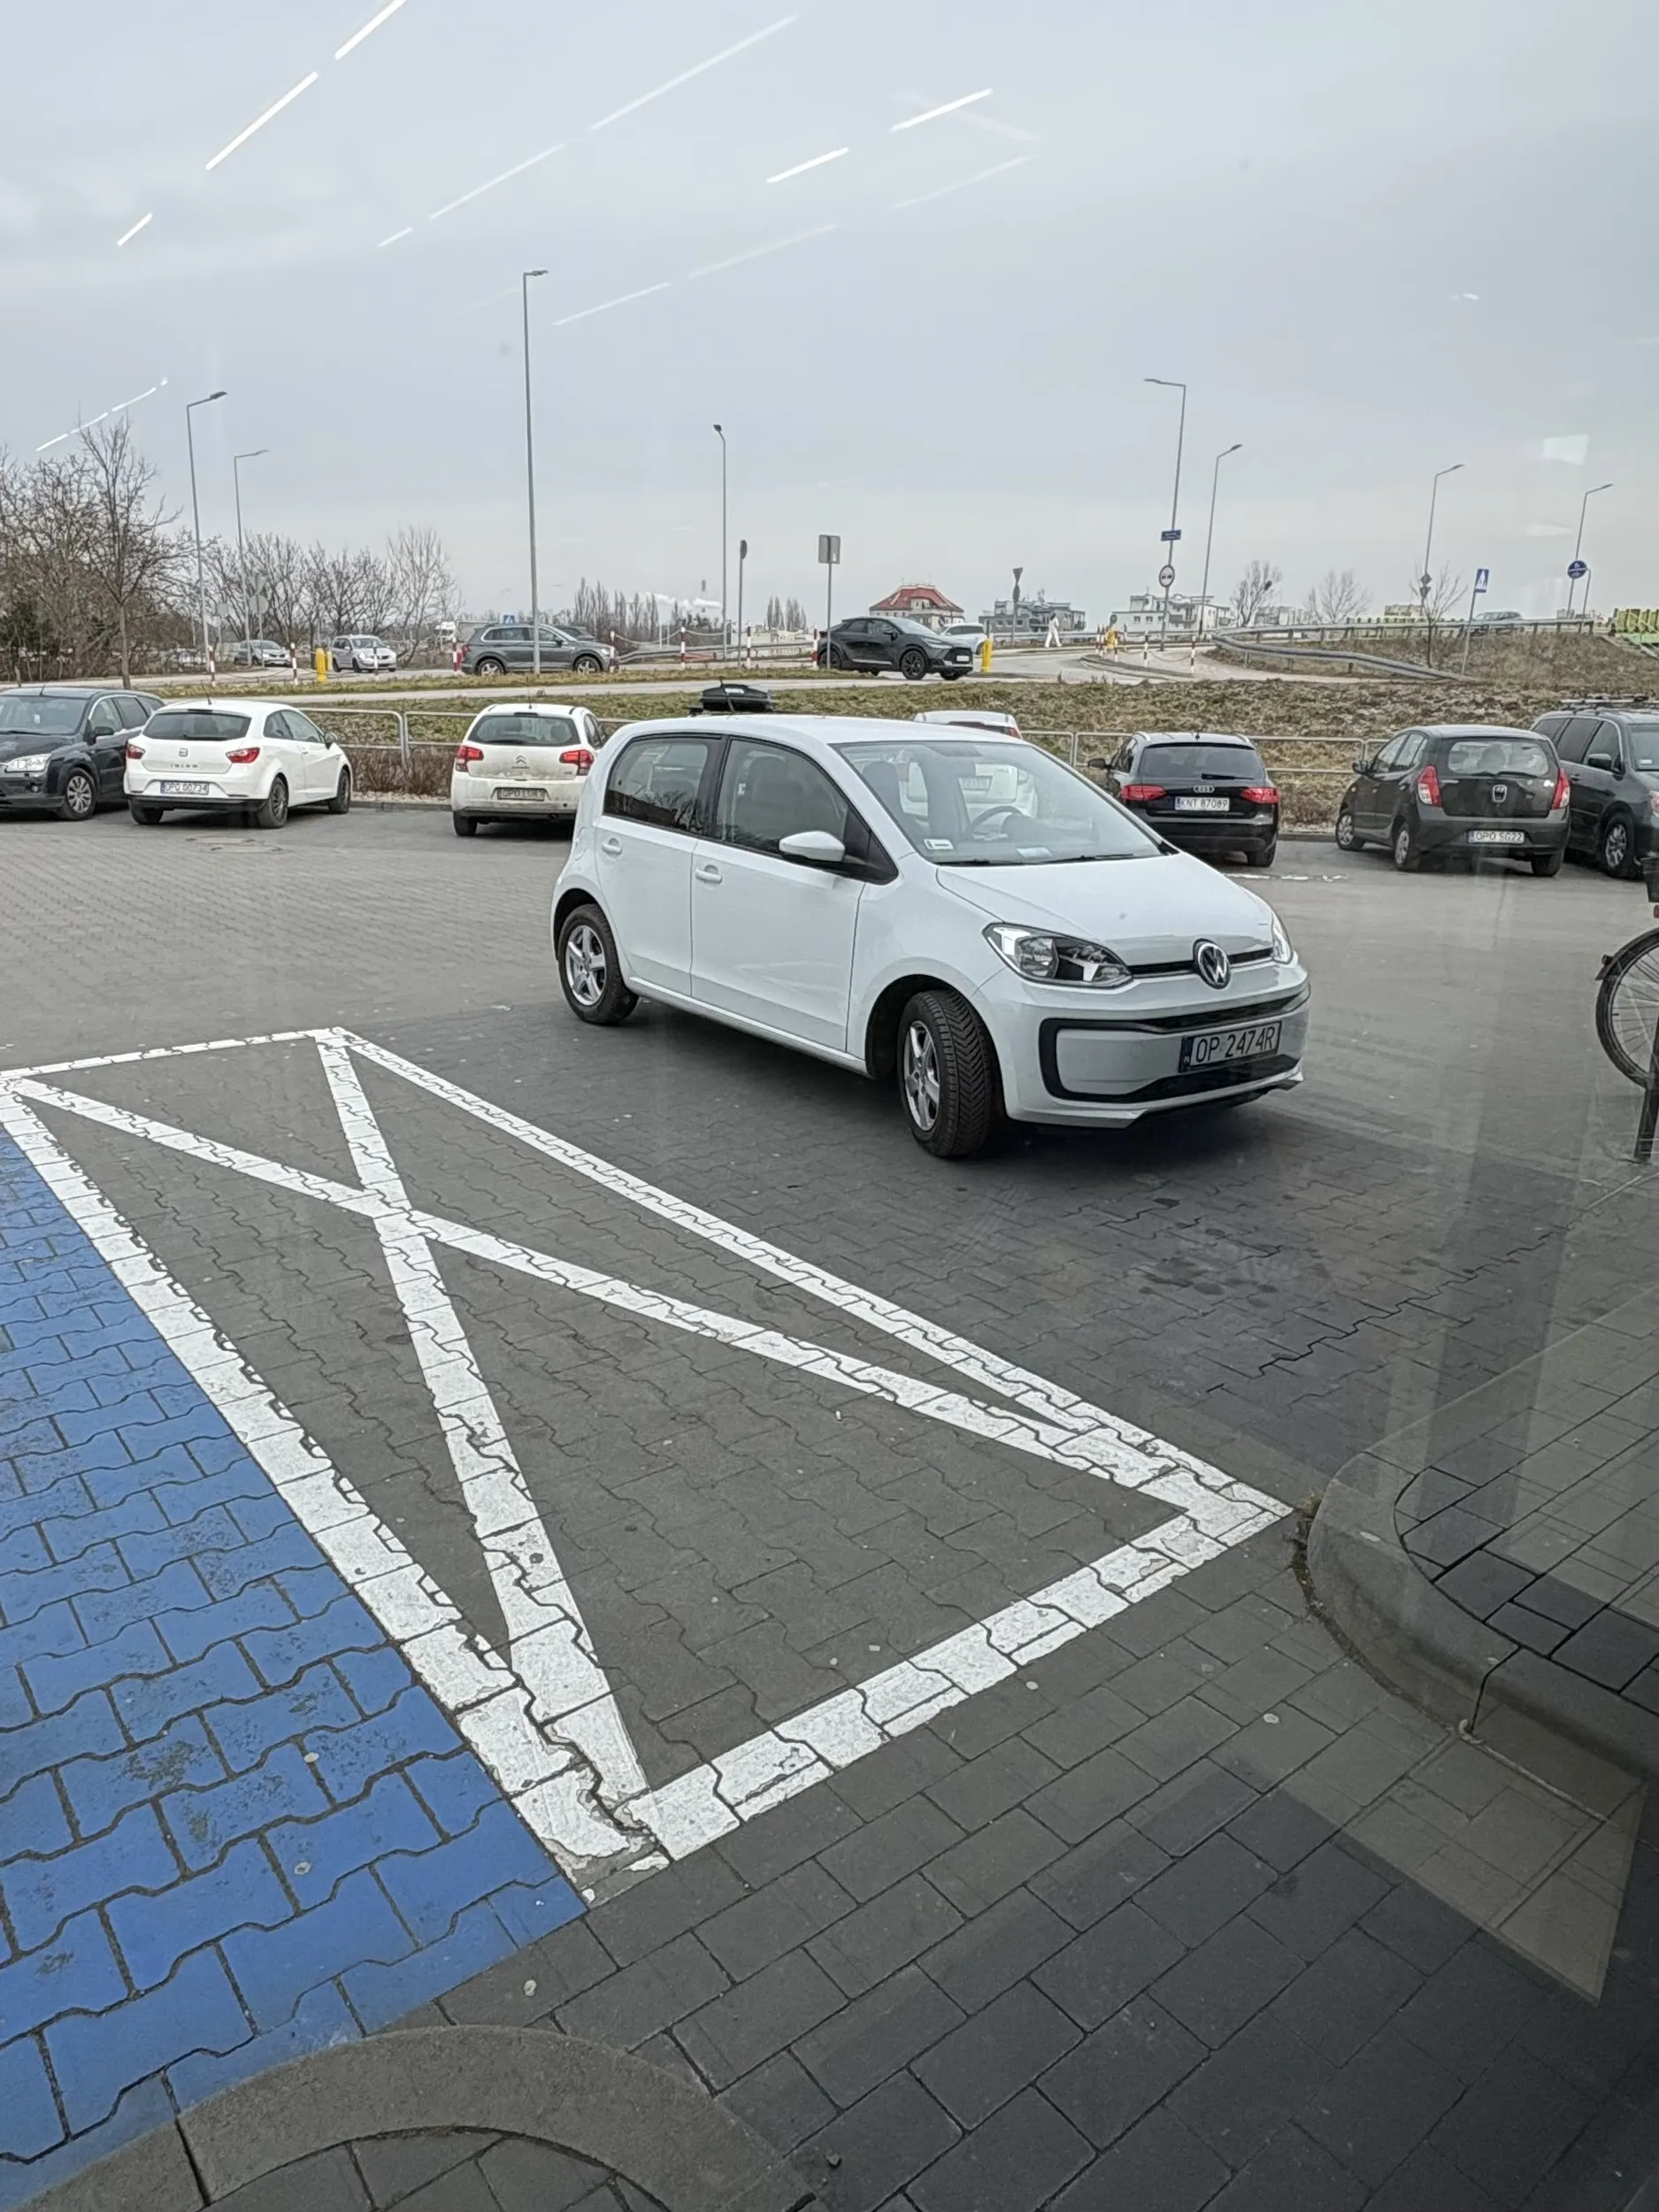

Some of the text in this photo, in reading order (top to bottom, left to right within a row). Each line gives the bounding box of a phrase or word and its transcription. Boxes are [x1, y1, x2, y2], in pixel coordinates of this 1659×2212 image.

[1476, 832, 1497, 841] OPO
[1195, 1025, 1276, 1063] OP 2474R
